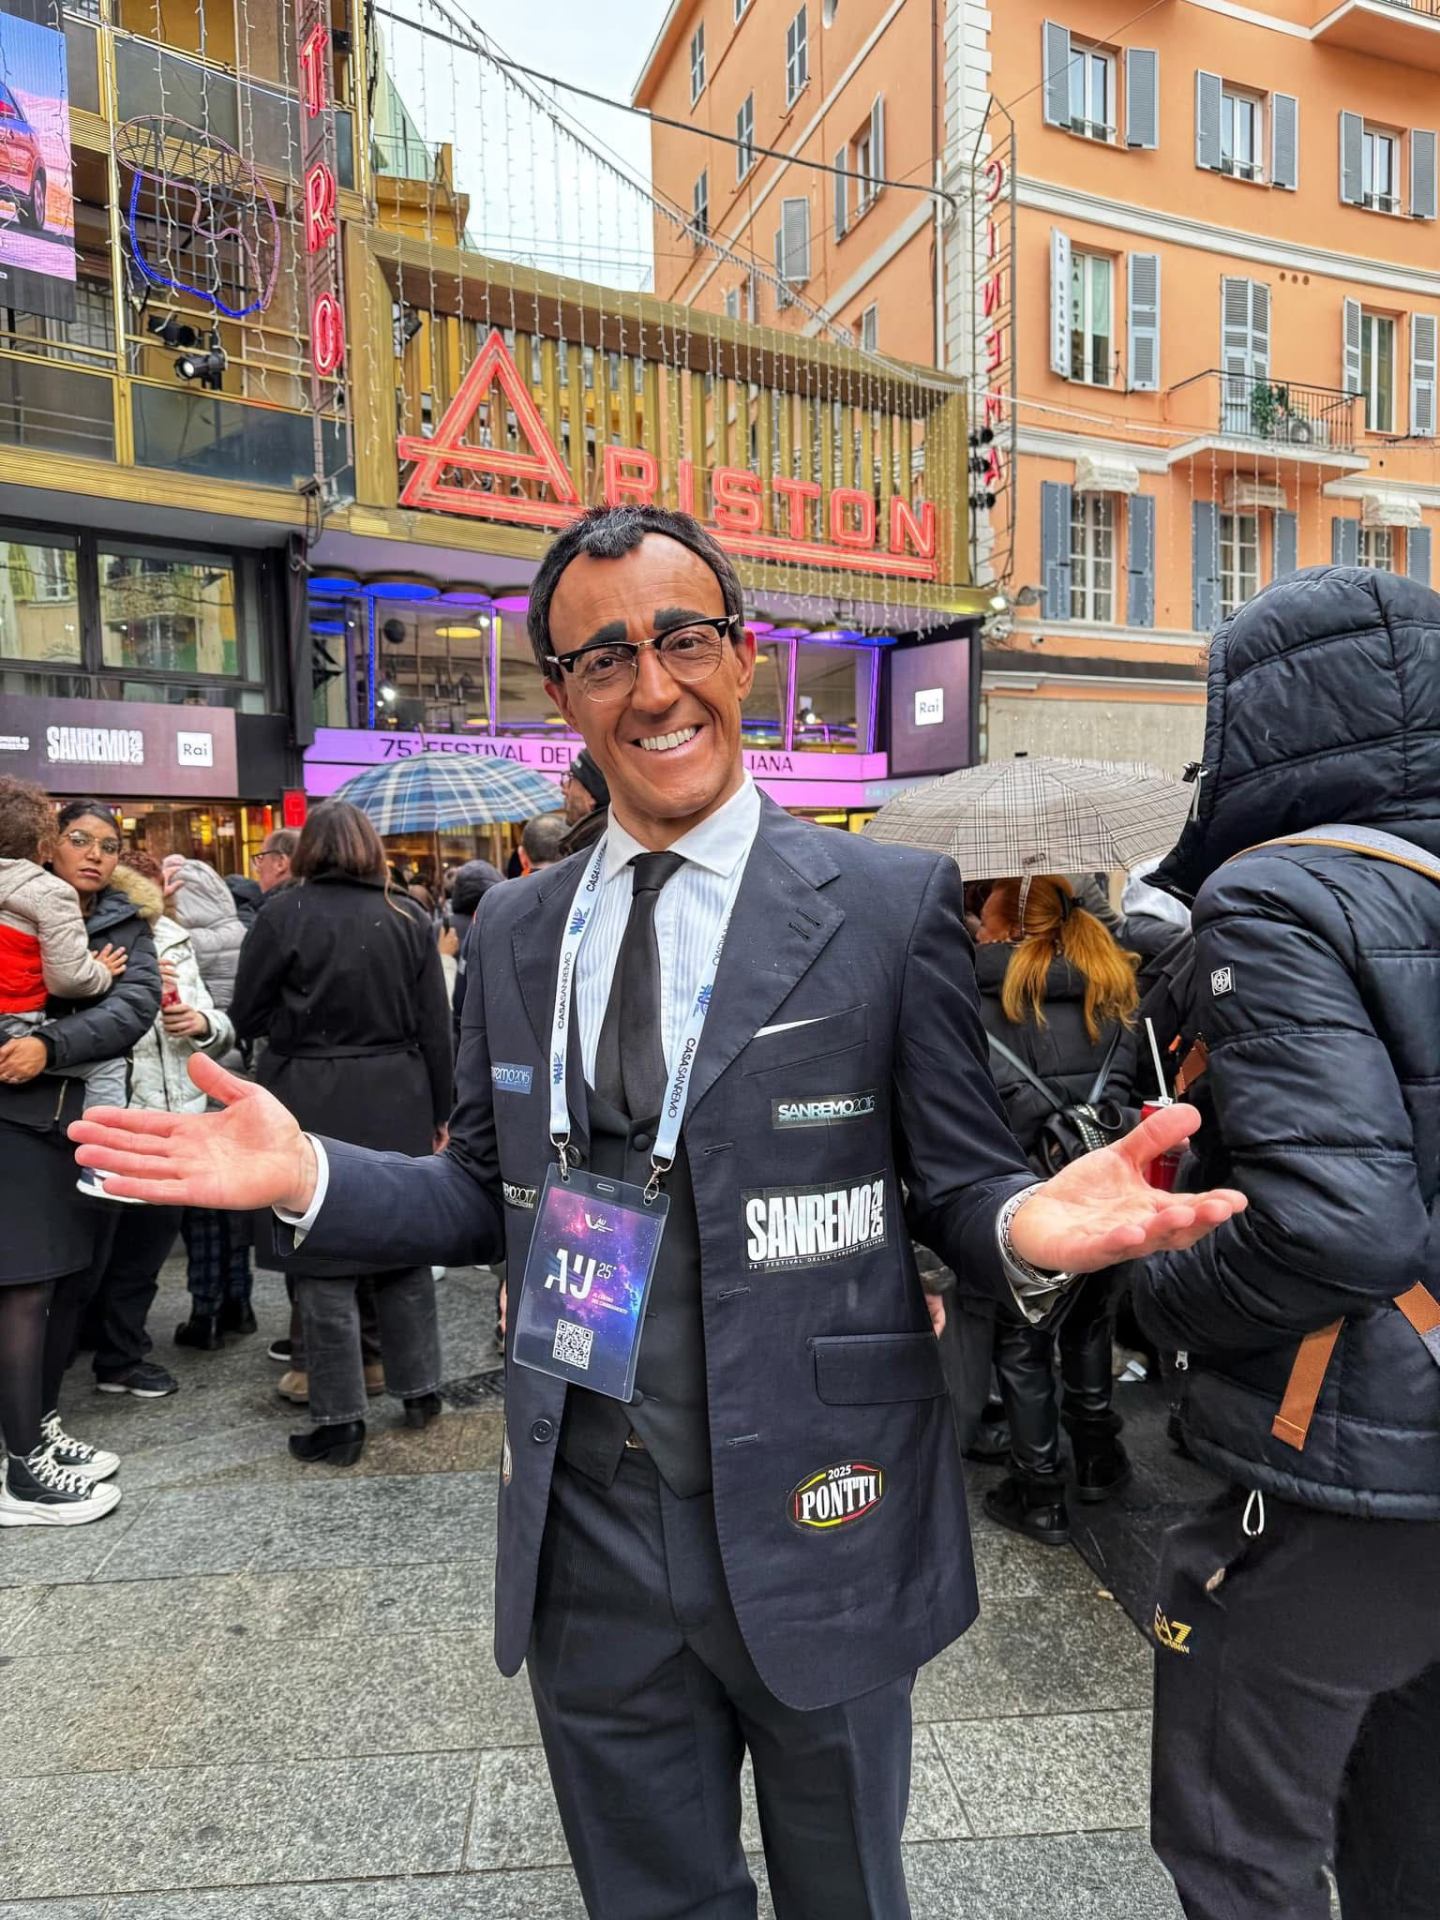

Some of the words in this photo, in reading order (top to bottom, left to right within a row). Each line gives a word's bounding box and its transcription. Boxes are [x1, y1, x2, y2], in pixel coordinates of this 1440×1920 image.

[398, 329, 937, 558] ARISTON
[919, 698, 940, 714] Rai
[46, 726, 129, 763] SANREMO
[183, 742, 208, 757] Rai
[557, 951, 572, 1030] CASASANREMO
[667, 1036, 697, 1120] CASASANREMO
[745, 1184, 873, 1261] SANREMO
[827, 1464, 853, 1481] 2025
[801, 1475, 877, 1519] PONTTI
